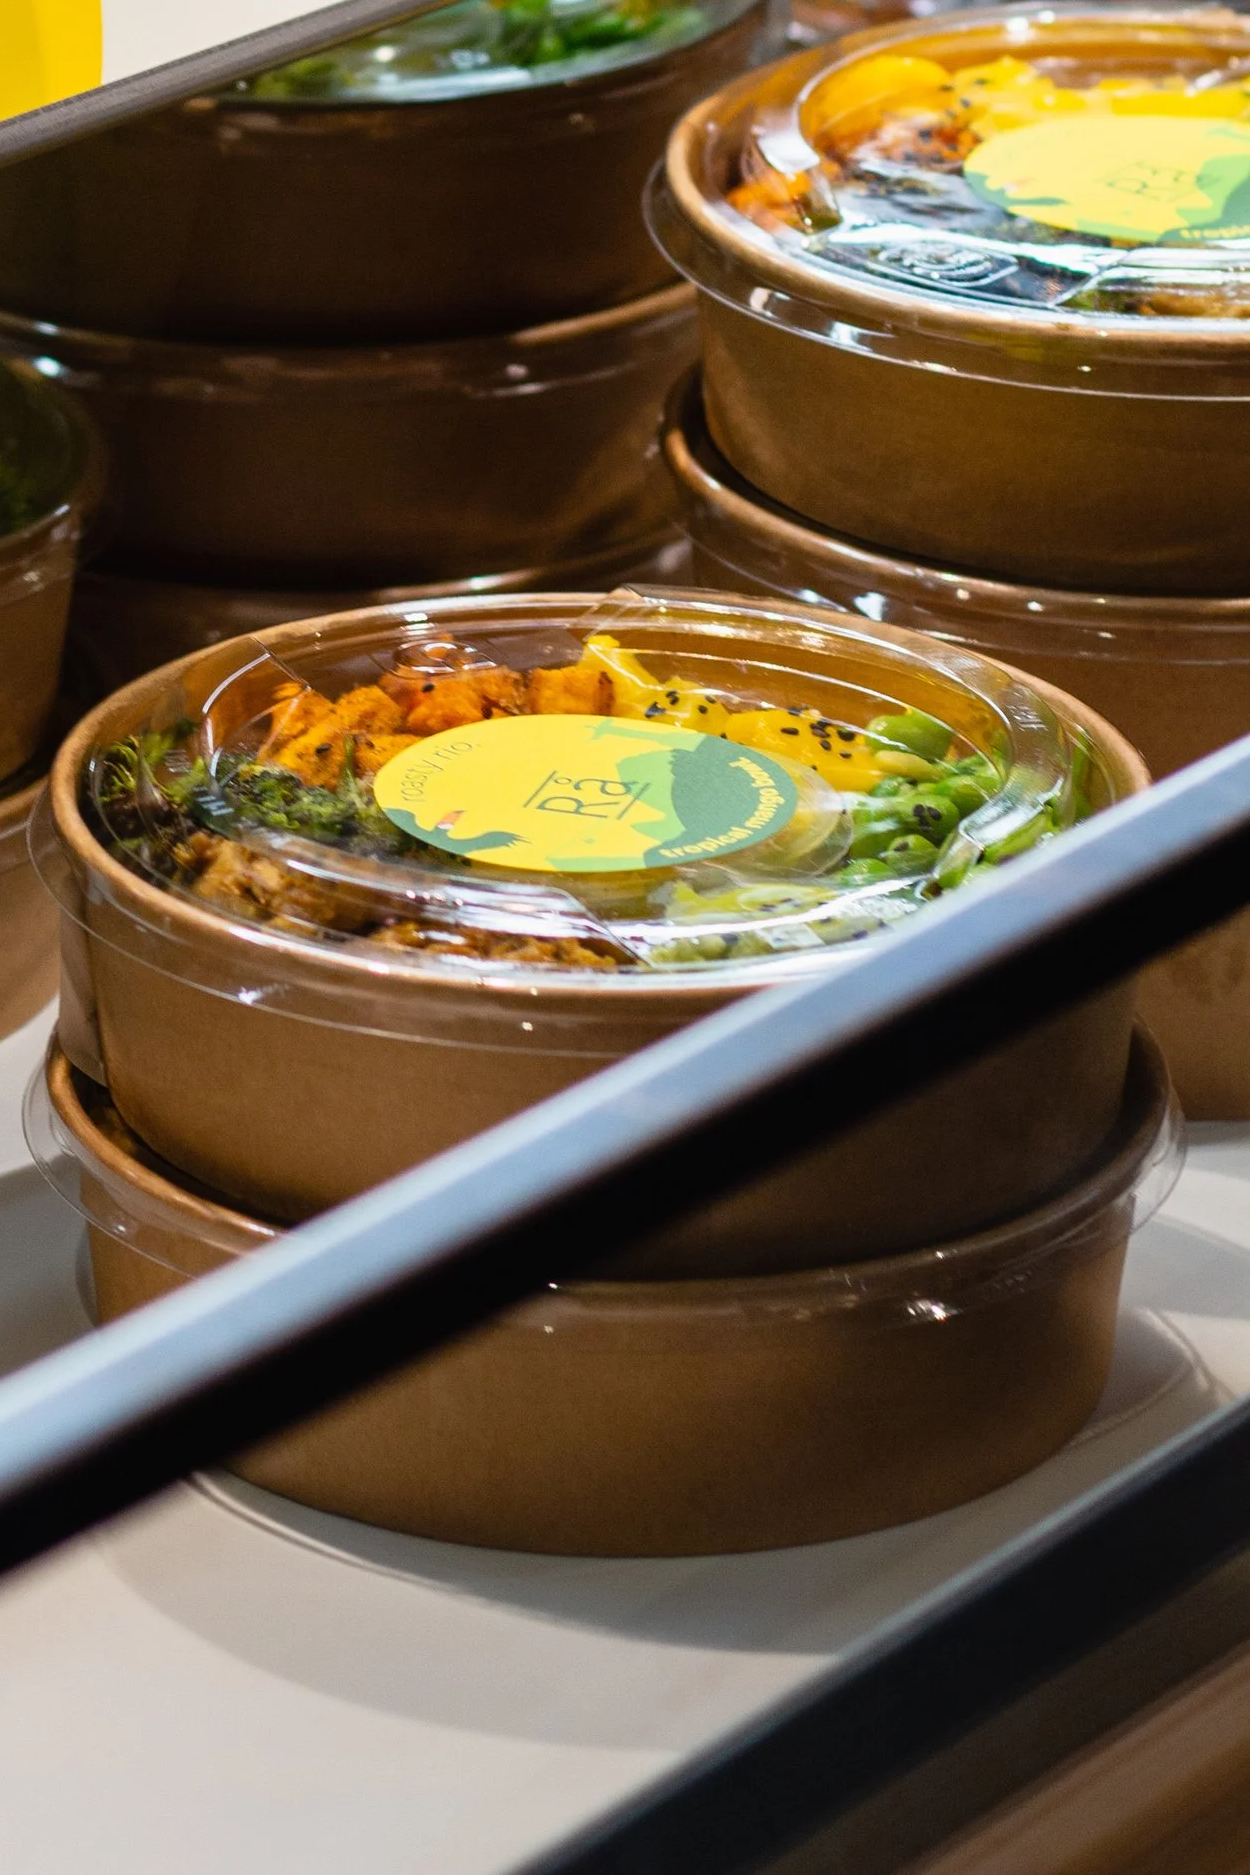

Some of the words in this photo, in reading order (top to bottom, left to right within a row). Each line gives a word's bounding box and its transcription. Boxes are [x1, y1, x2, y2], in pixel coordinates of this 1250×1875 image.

[402, 758, 445, 805] roasty
[535, 776, 639, 820] Rå
[657, 825, 755, 859] tropical
[743, 787, 786, 830] mango
